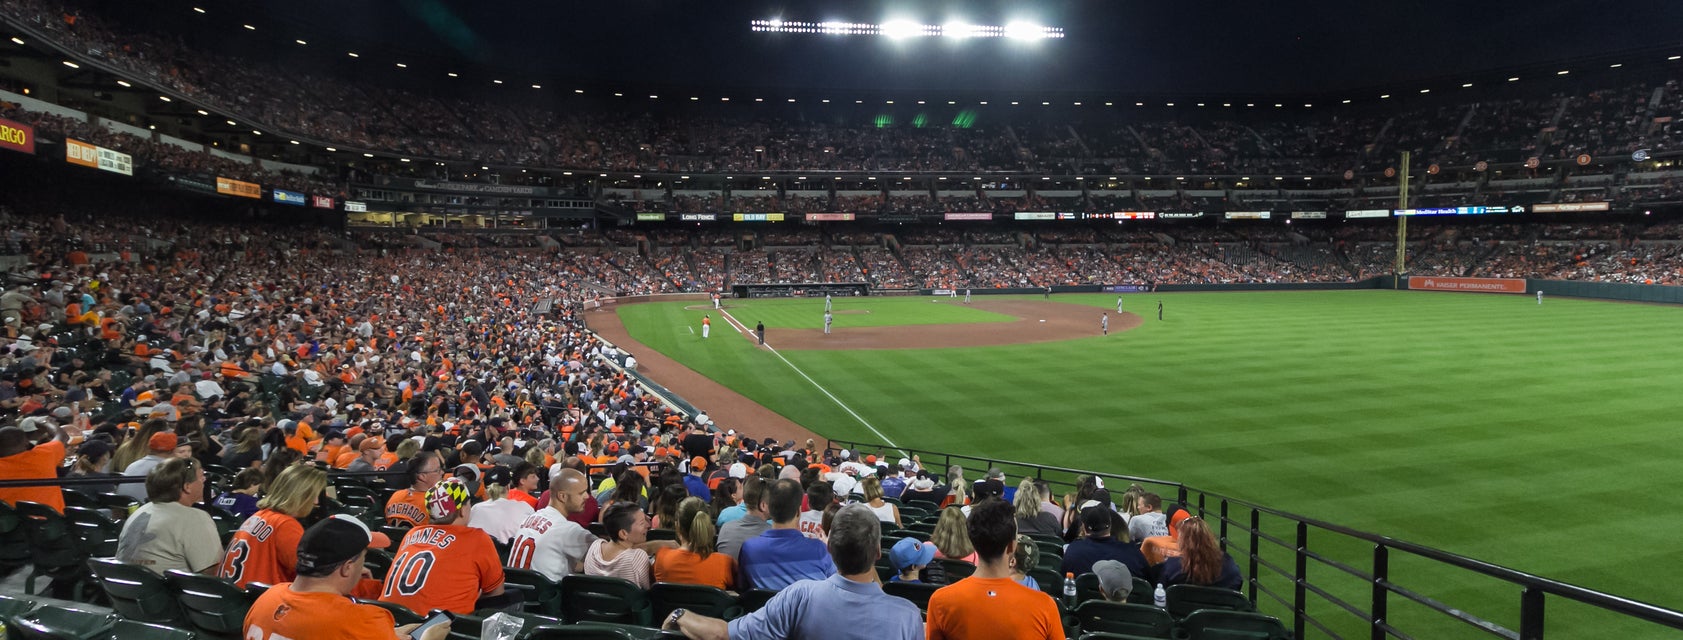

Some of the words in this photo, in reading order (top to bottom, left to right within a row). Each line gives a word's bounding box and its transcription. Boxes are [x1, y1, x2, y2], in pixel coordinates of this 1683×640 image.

[0, 124, 26, 145] RGO
[386, 502, 427, 523] MACHADO
[520, 515, 553, 535] JONES
[401, 527, 456, 551] JONES
[507, 534, 536, 570] 10
[384, 549, 436, 597] 10
